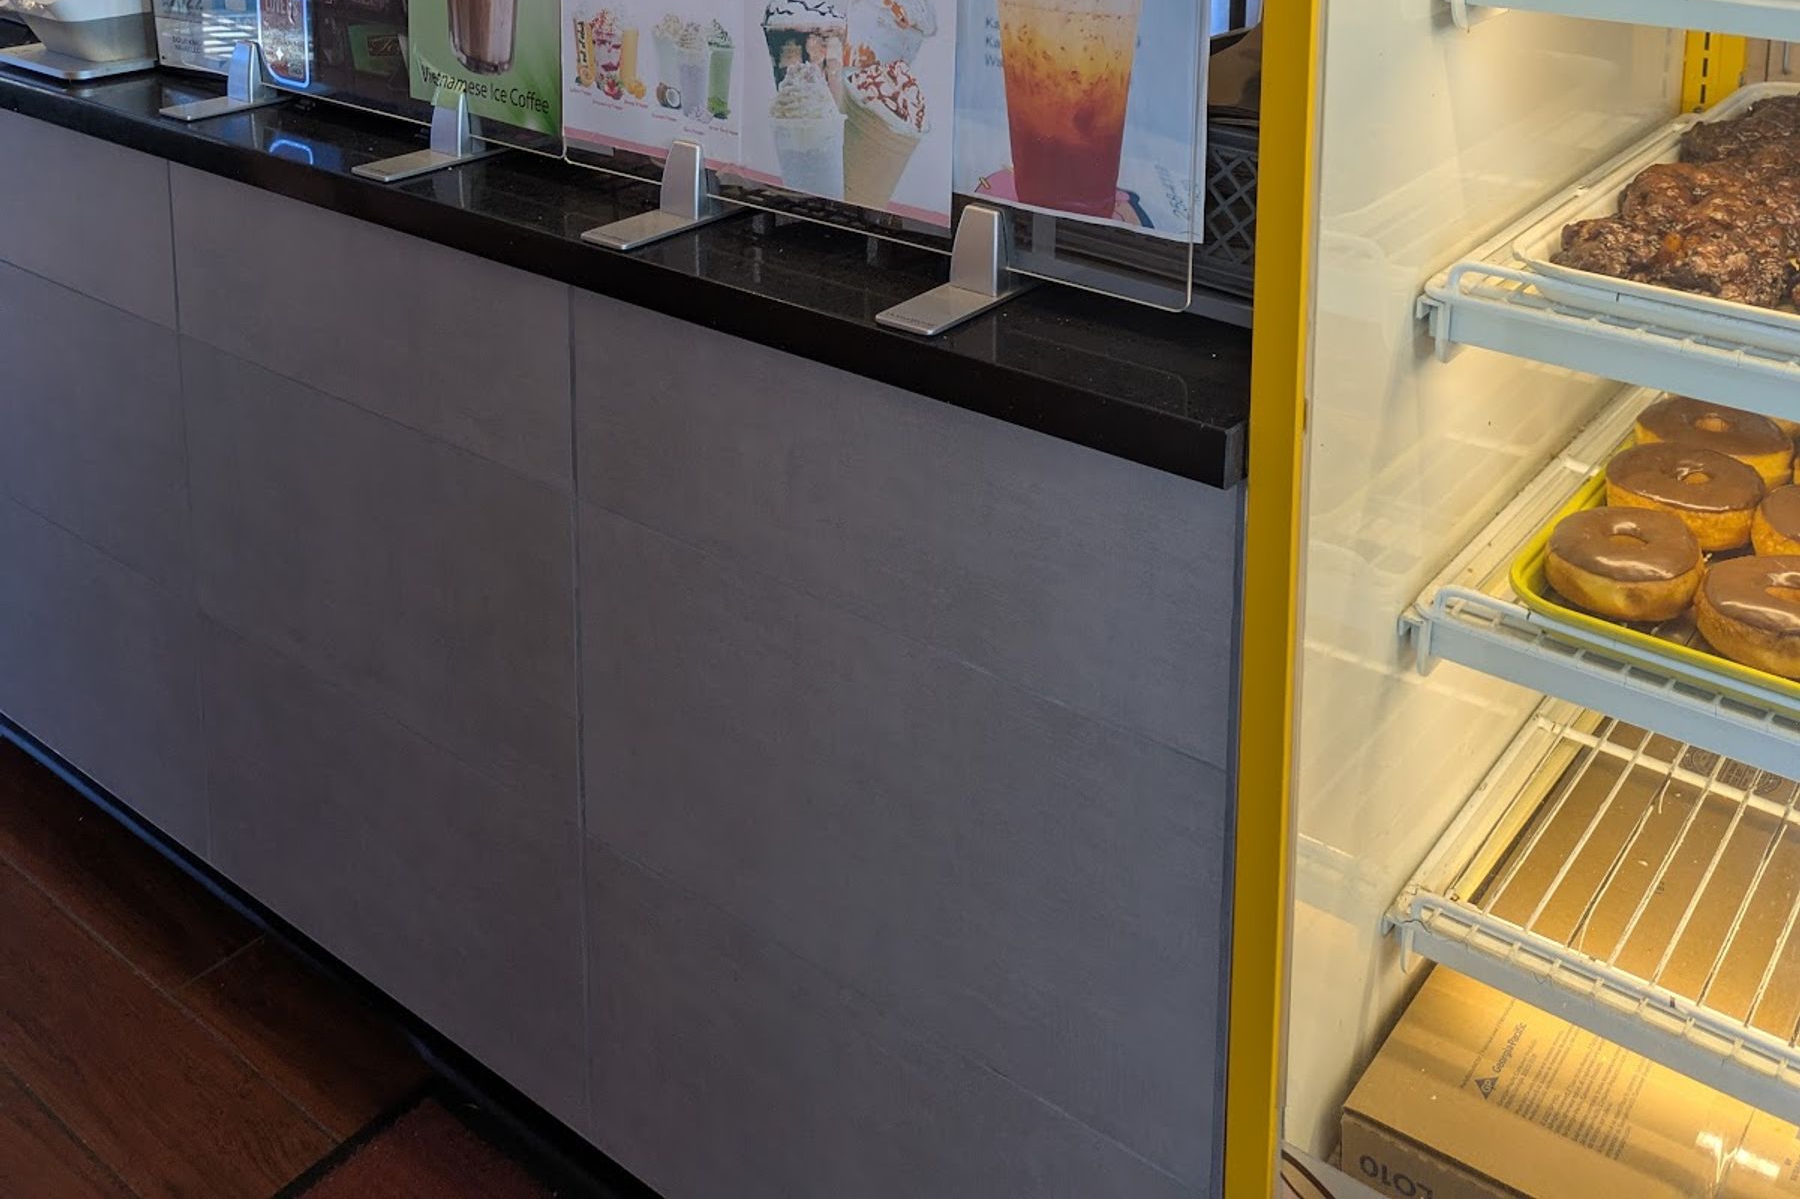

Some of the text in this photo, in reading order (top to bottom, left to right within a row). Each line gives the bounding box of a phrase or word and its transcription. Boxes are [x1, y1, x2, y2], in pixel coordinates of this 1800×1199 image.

[421, 64, 550, 114] Vietnamese Ice Coffee
